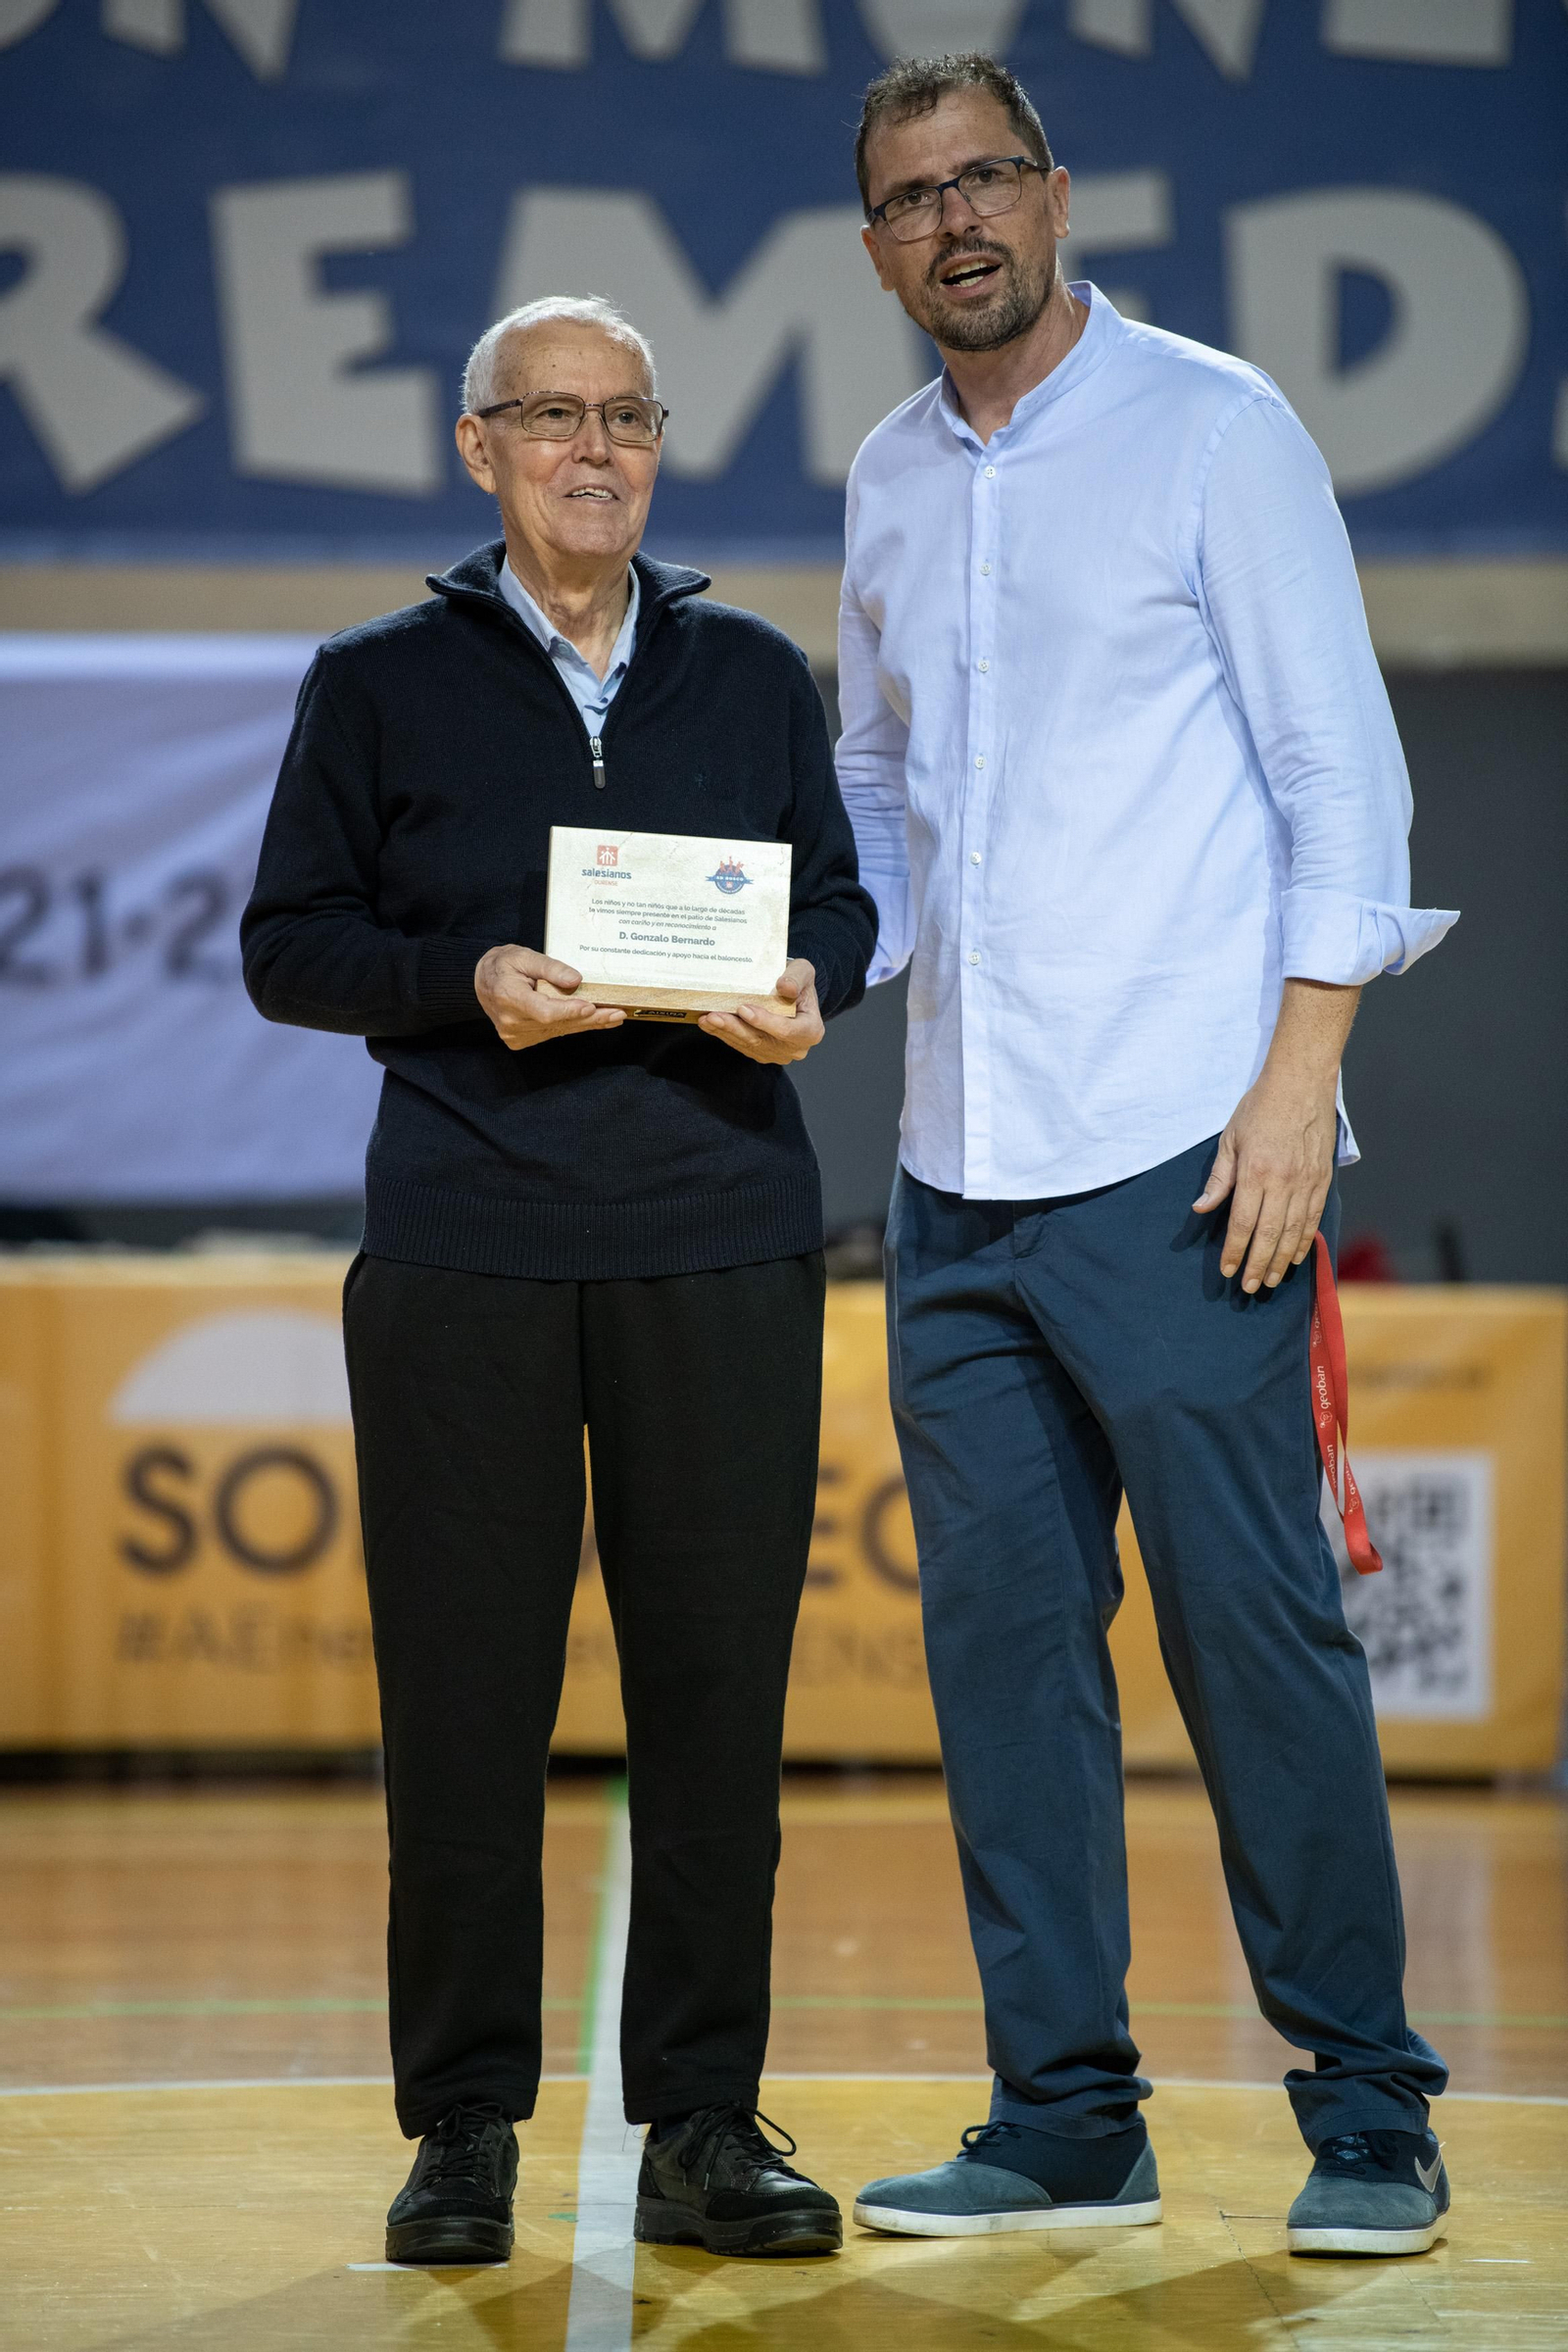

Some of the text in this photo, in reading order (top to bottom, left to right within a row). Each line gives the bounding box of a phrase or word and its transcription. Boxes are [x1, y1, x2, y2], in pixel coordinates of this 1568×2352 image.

[582, 868, 632, 879] salesianos
[630, 933, 669, 943] Gonzalo
[671, 936, 715, 946] Bernardo
[1316, 1365, 1331, 1409] geoban
